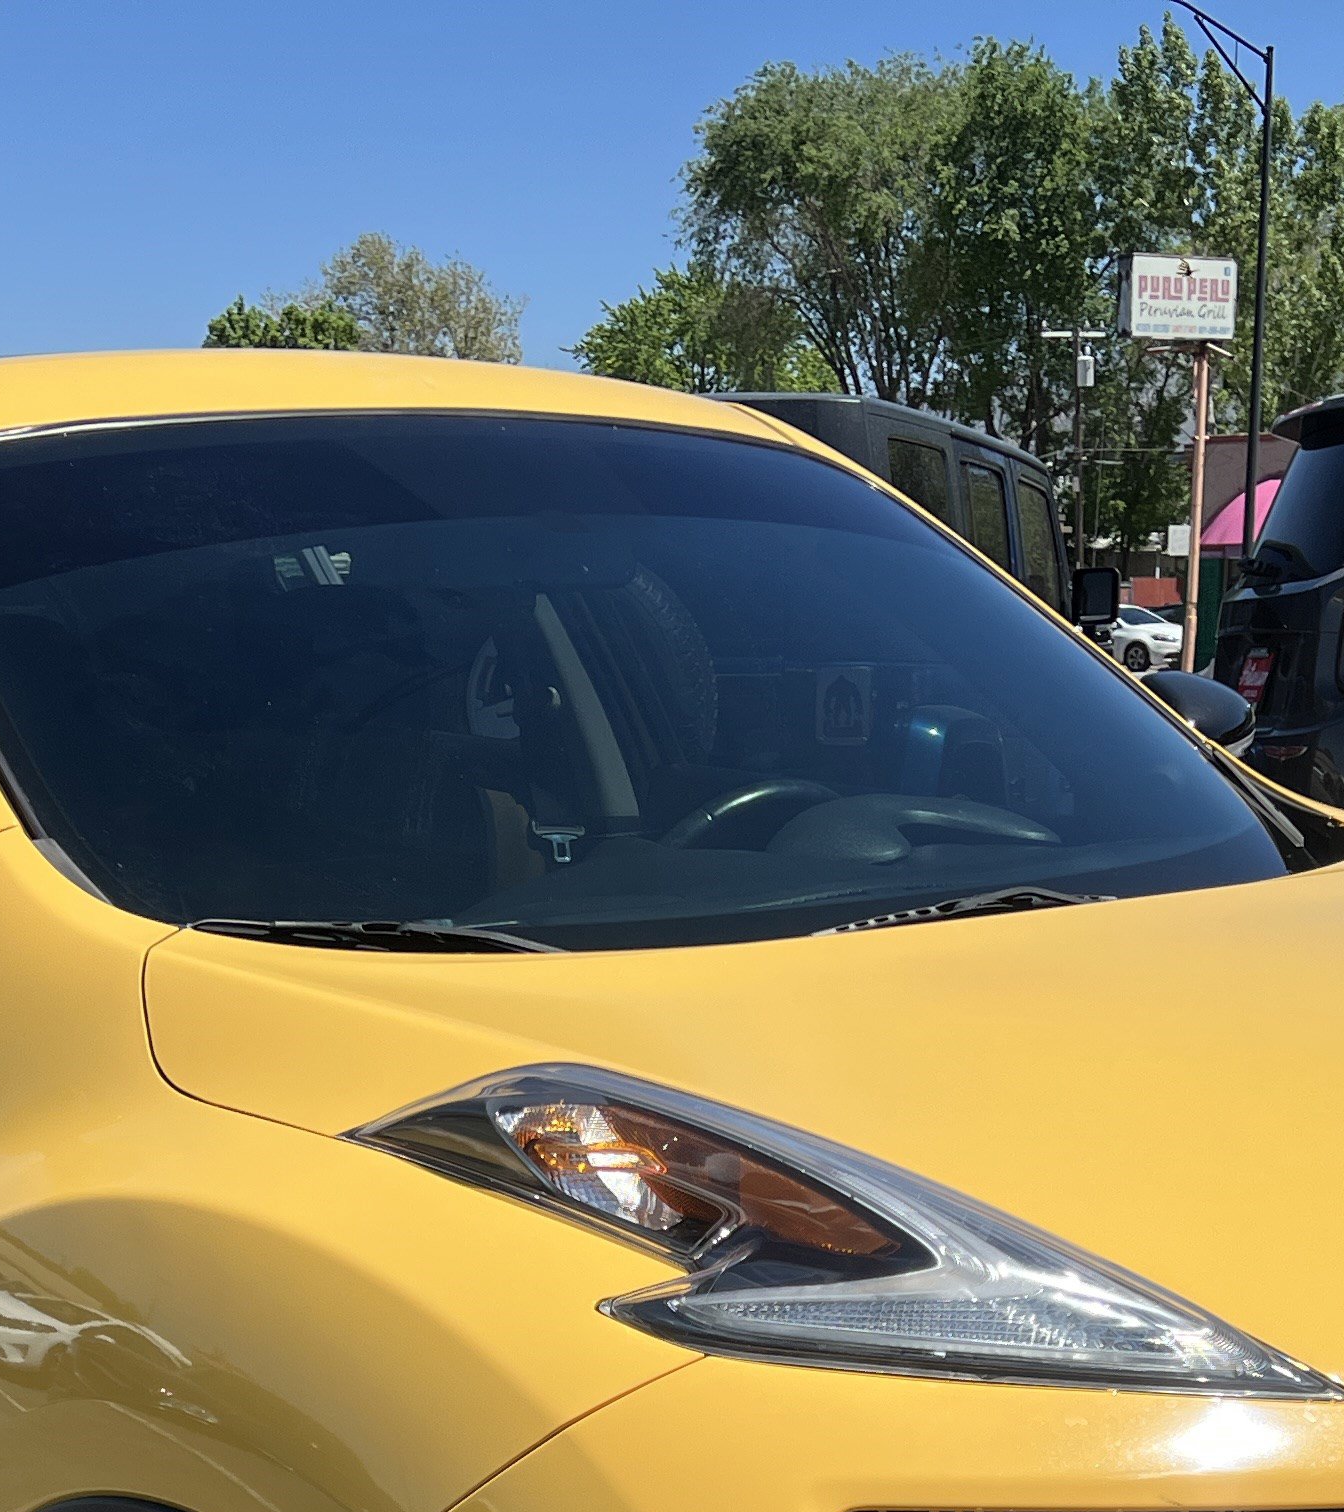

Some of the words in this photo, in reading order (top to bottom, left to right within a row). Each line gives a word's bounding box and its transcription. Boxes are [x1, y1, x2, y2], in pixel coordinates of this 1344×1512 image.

[1187, 277, 1230, 303] PERU
[1139, 302, 1195, 318] Peruvian
[1197, 303, 1227, 319] Grill
